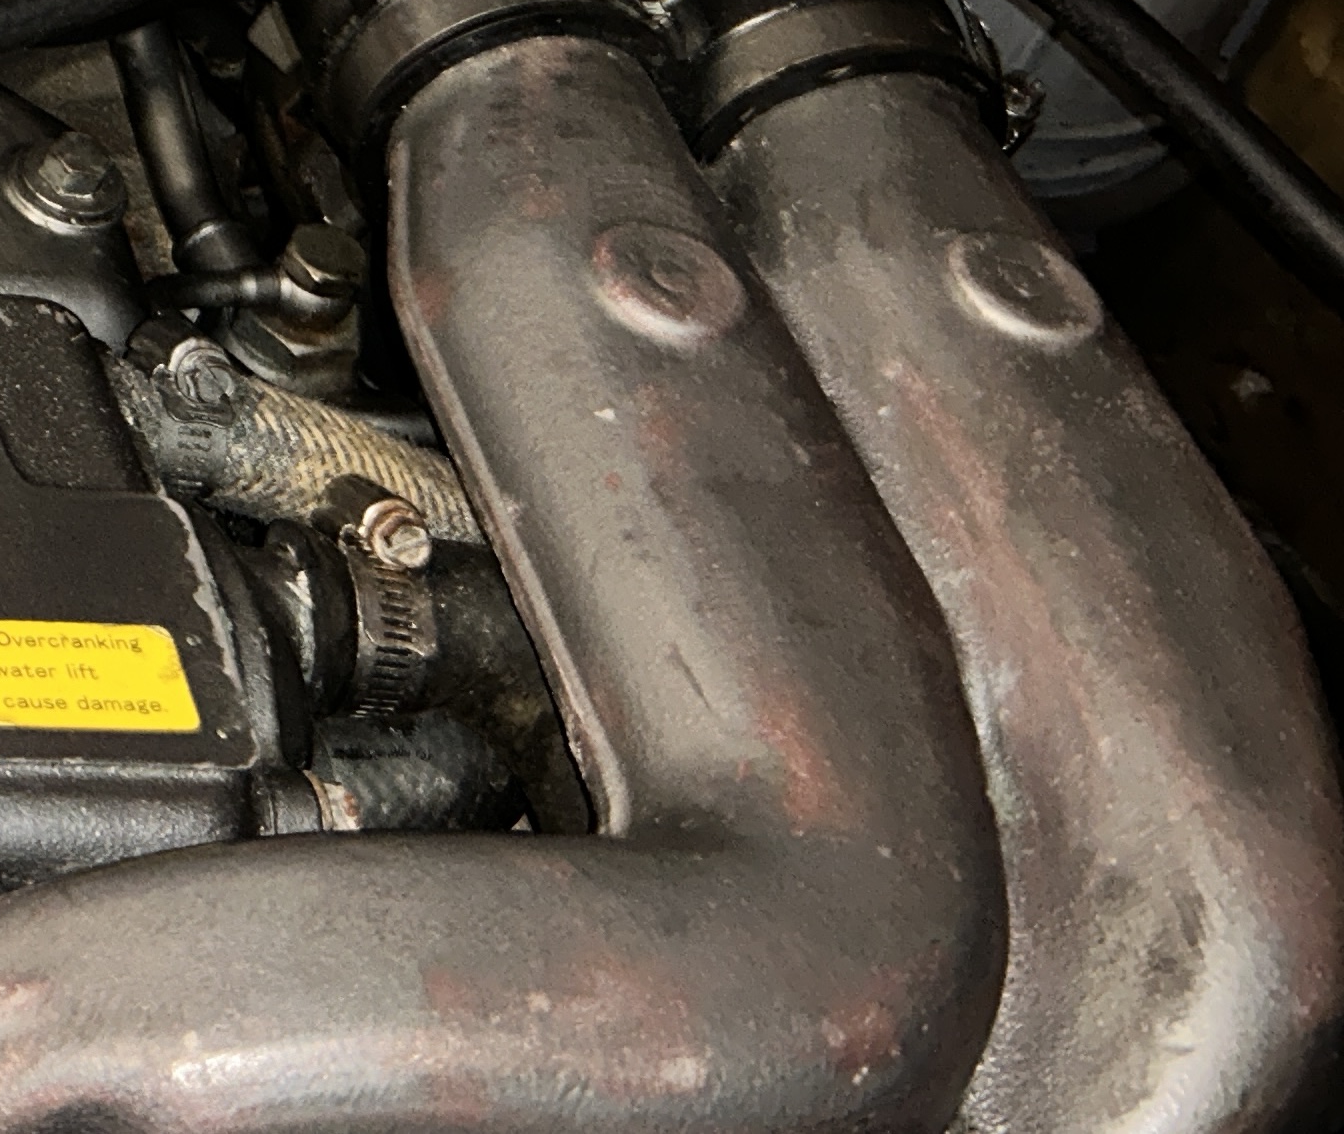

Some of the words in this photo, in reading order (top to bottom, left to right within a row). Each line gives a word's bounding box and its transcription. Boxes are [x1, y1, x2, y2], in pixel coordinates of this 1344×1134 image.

[66, 663, 99, 680] lift
[3, 695, 67, 710] cause
[77, 694, 169, 715] damage.
